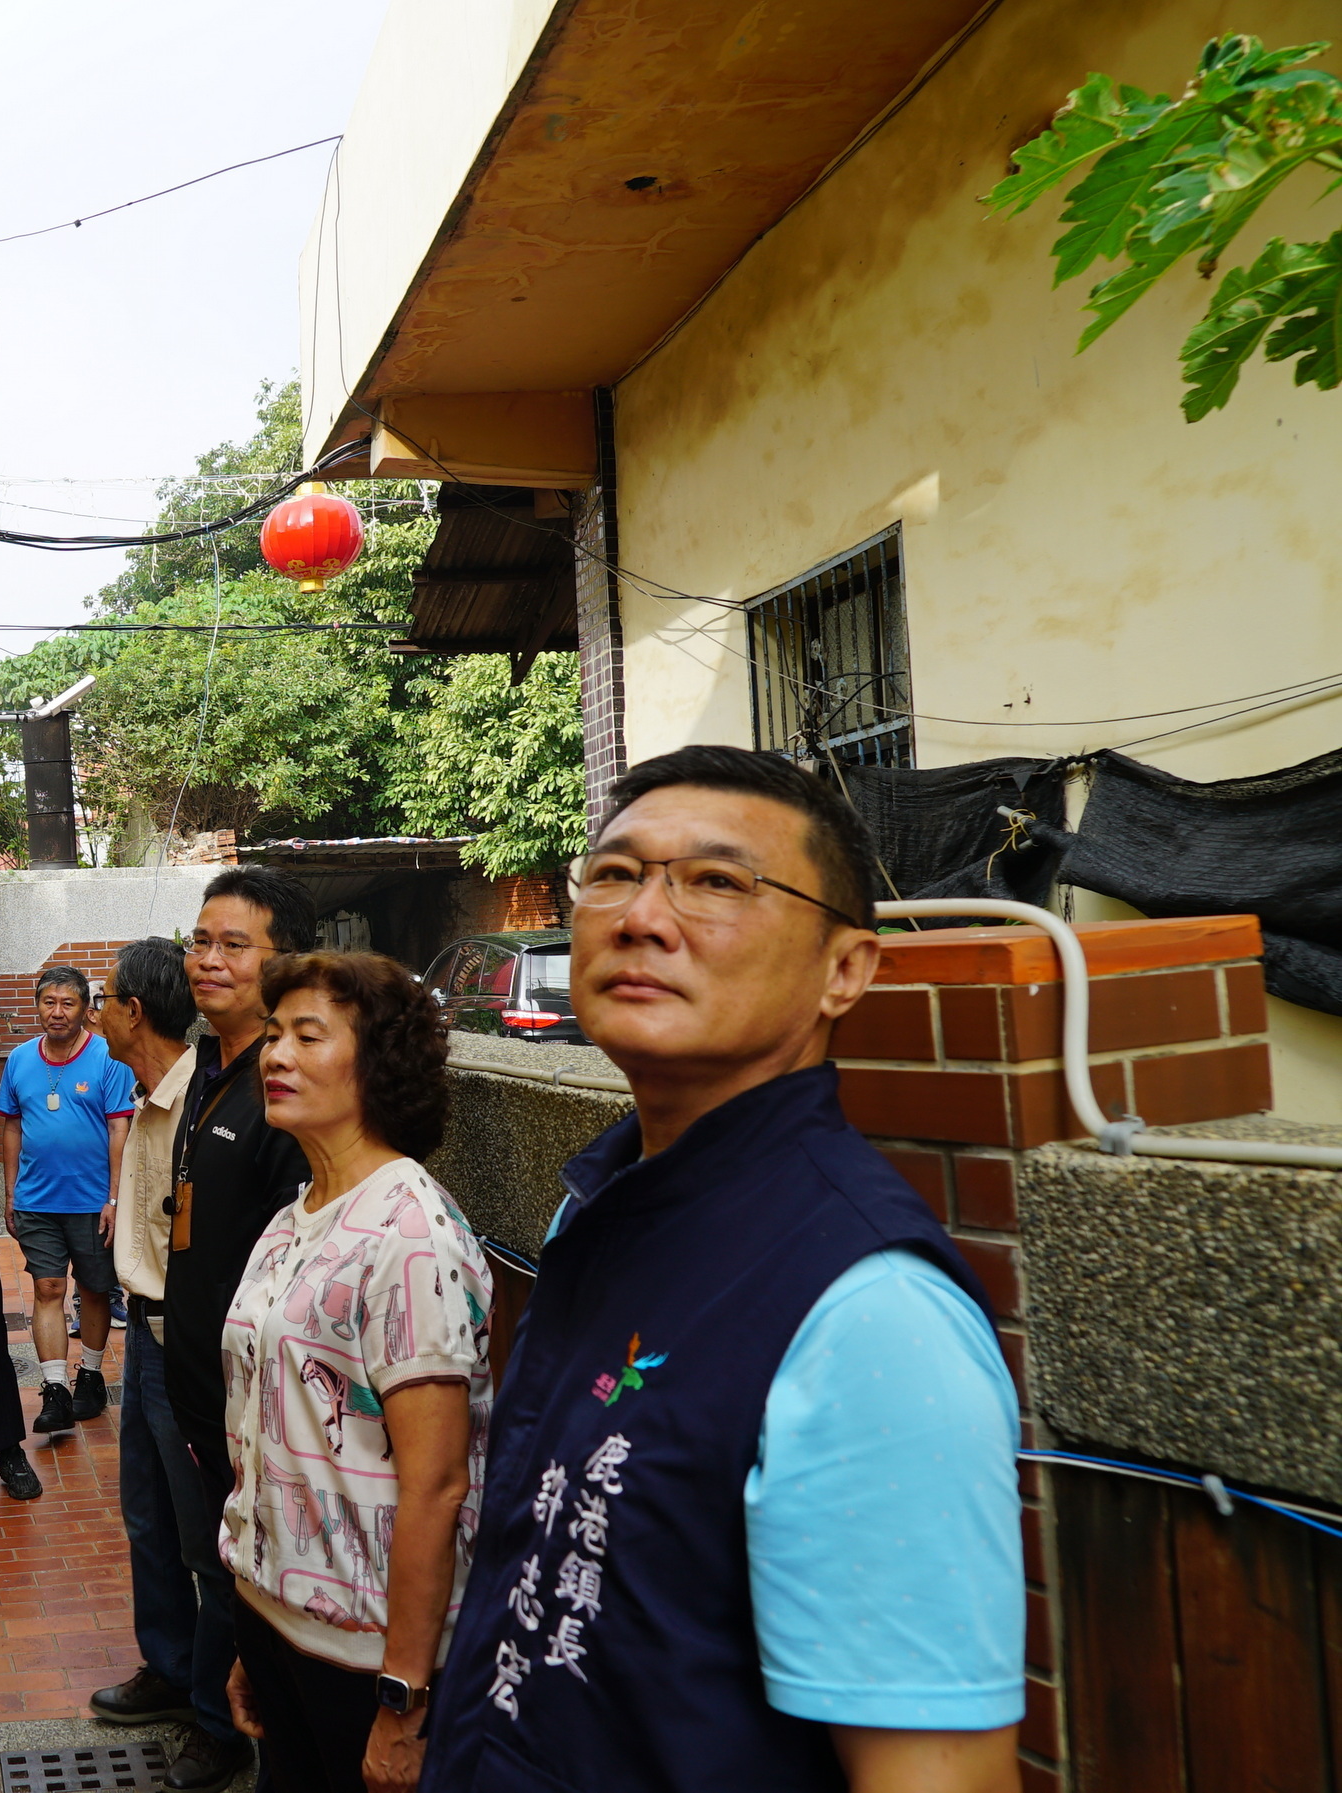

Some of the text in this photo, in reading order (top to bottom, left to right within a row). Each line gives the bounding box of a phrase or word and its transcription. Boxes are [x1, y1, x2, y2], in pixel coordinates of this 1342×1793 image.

[212, 1124, 236, 1142] adidas
[486, 1458, 569, 1722] 許志宏
[544, 1432, 632, 1684] 鹿港鎮長
